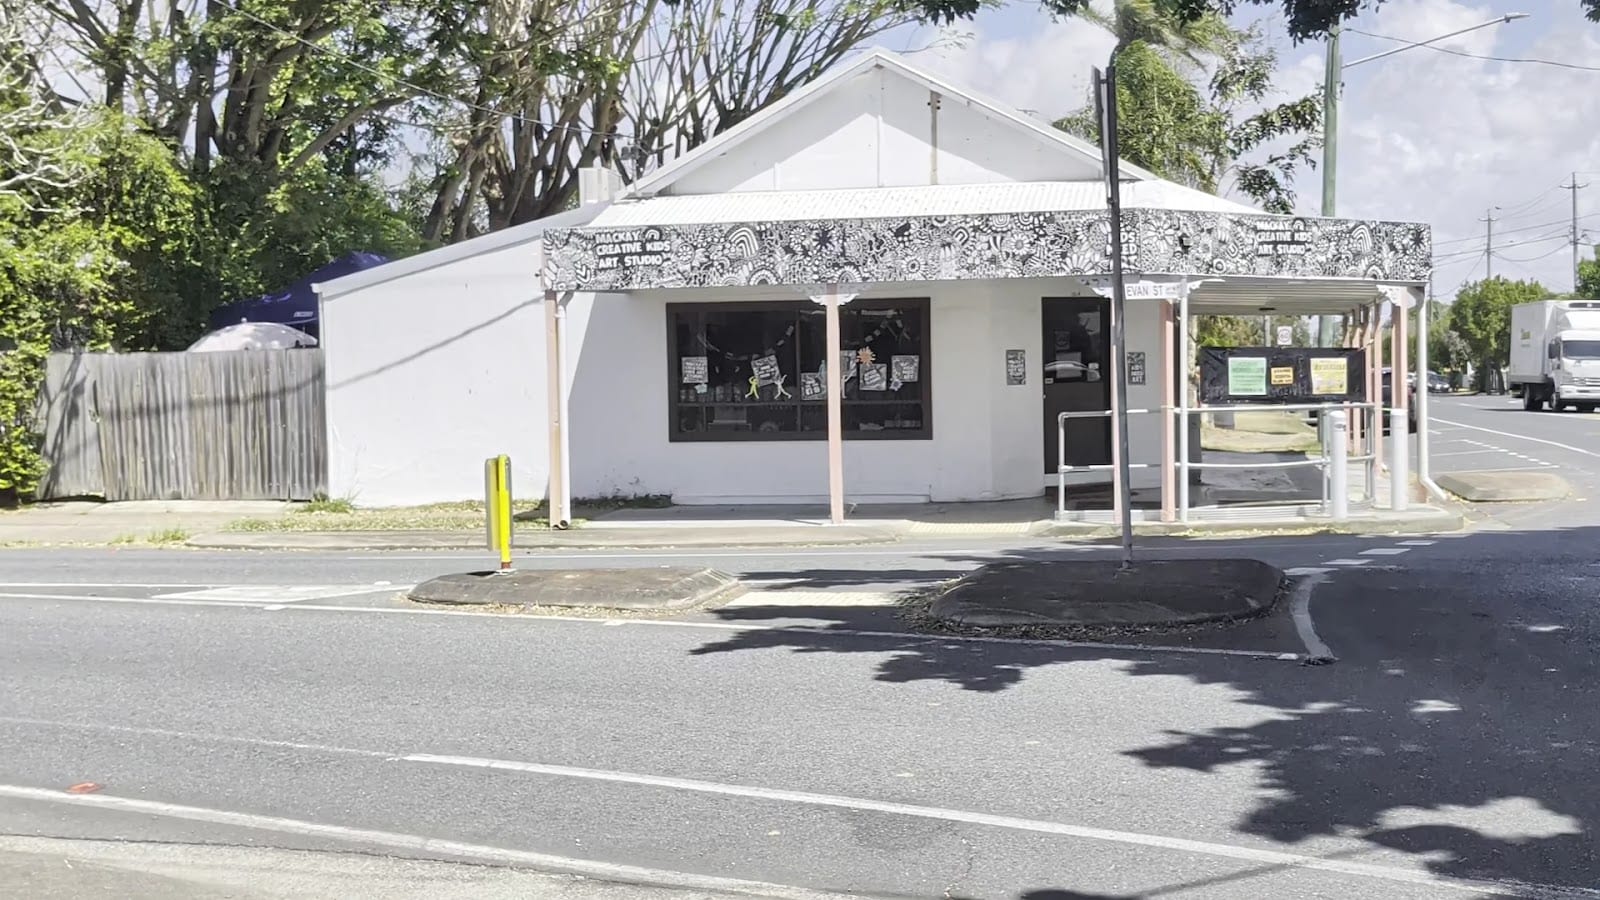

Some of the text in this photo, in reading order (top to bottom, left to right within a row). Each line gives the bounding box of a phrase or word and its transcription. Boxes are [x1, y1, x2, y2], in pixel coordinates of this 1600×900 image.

[596, 231, 640, 244] MACKAY
[1256, 230, 1313, 242] CREATIVE KIDS
[596, 241, 671, 256] CREATIVE KIDS
[1258, 244, 1306, 255] ART STUDIO
[598, 254, 663, 269] ART STUDIO
[1126, 285, 1149, 297] EVAN
[1153, 285, 1164, 297] ST
